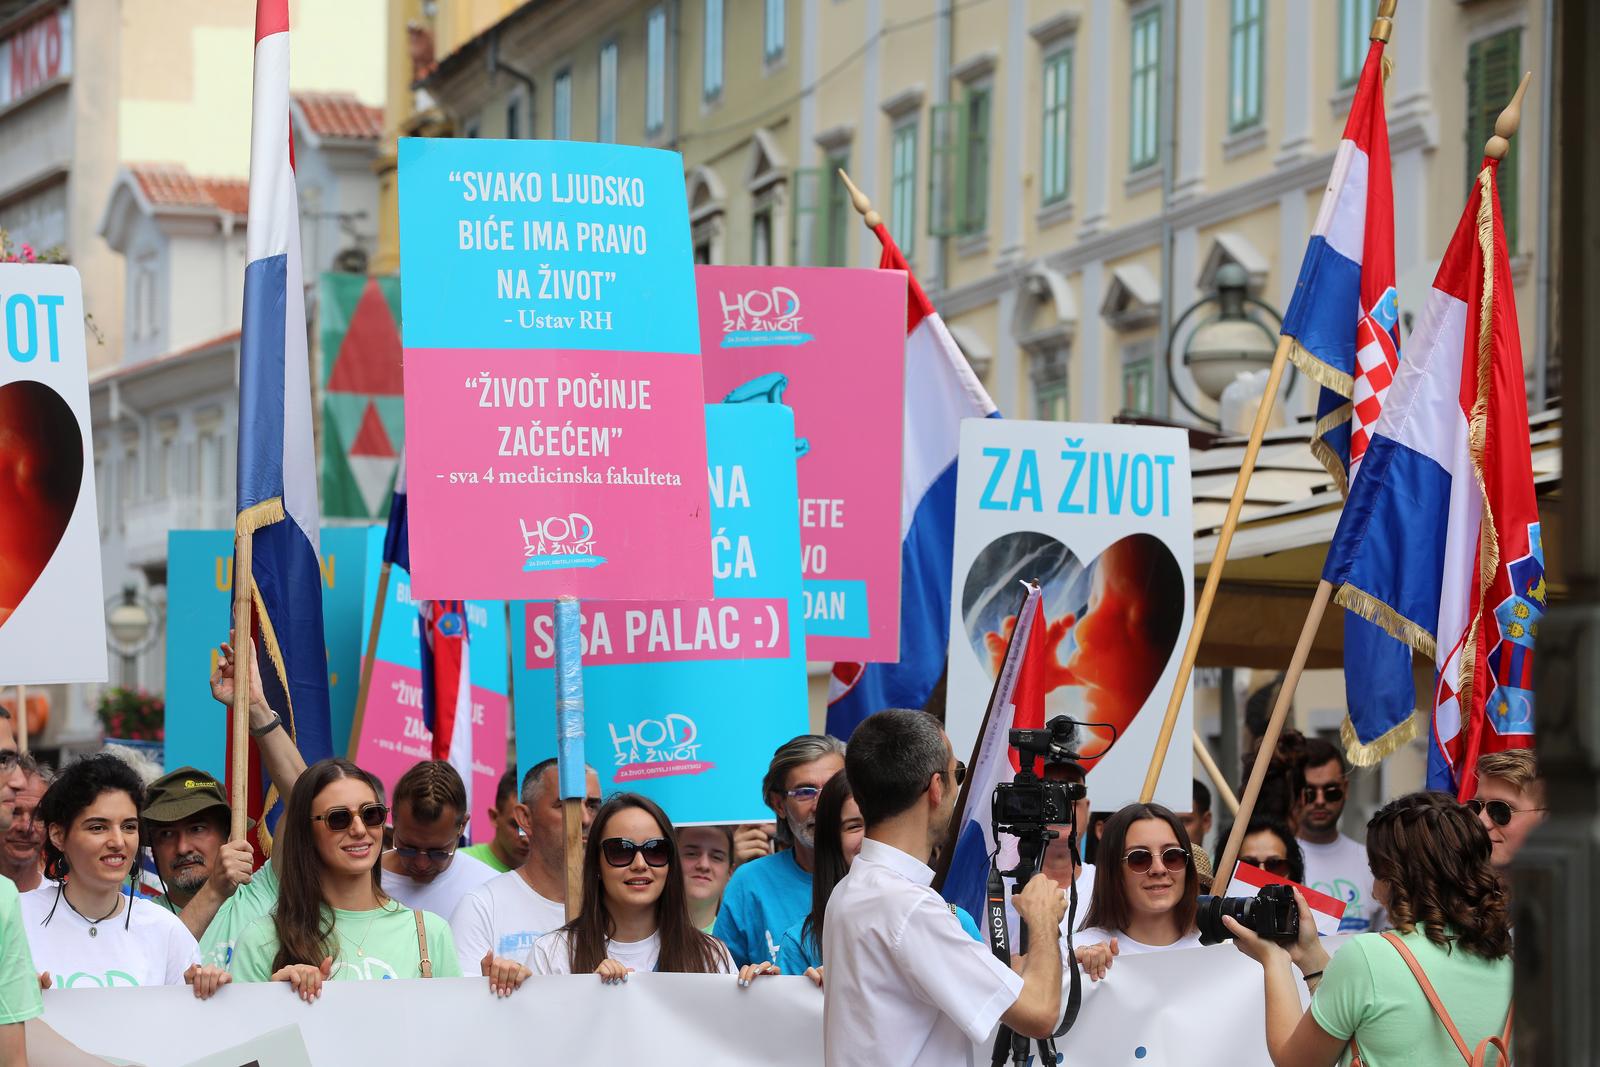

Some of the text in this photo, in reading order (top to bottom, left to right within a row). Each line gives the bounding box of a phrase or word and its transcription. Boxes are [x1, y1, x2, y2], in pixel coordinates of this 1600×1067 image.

[449, 171, 645, 208] “SVAKO LJUDSKO
[458, 214, 647, 255] BIĆE IMA PRAVO
[497, 264, 616, 301] NA ŽIVOT”
[518, 309, 575, 329] Ustav
[579, 310, 613, 330] RH
[719, 286, 801, 321] HOD
[0, 293, 64, 363] OT
[722, 316, 805, 333] ZA ŽIVOT
[465, 371, 651, 410] “ŽIVOT POČINJE
[498, 420, 623, 457] ZAČEĆEM”
[449, 471, 479, 484] sva
[483, 467, 495, 484] 4
[499, 466, 602, 485] medicinska
[606, 467, 682, 487] fakulteta
[979, 437, 1175, 517] ZA ŽIVOT
[519, 512, 594, 548] HOD
[798, 498, 845, 528] ETE
[523, 541, 598, 557] ZA ŽIVOT
[533, 605, 780, 659] SA PALAC :)
[608, 713, 698, 753] HOD
[614, 744, 703, 766] ZA ŽIVOT
[993, 906, 1005, 950] SONY
